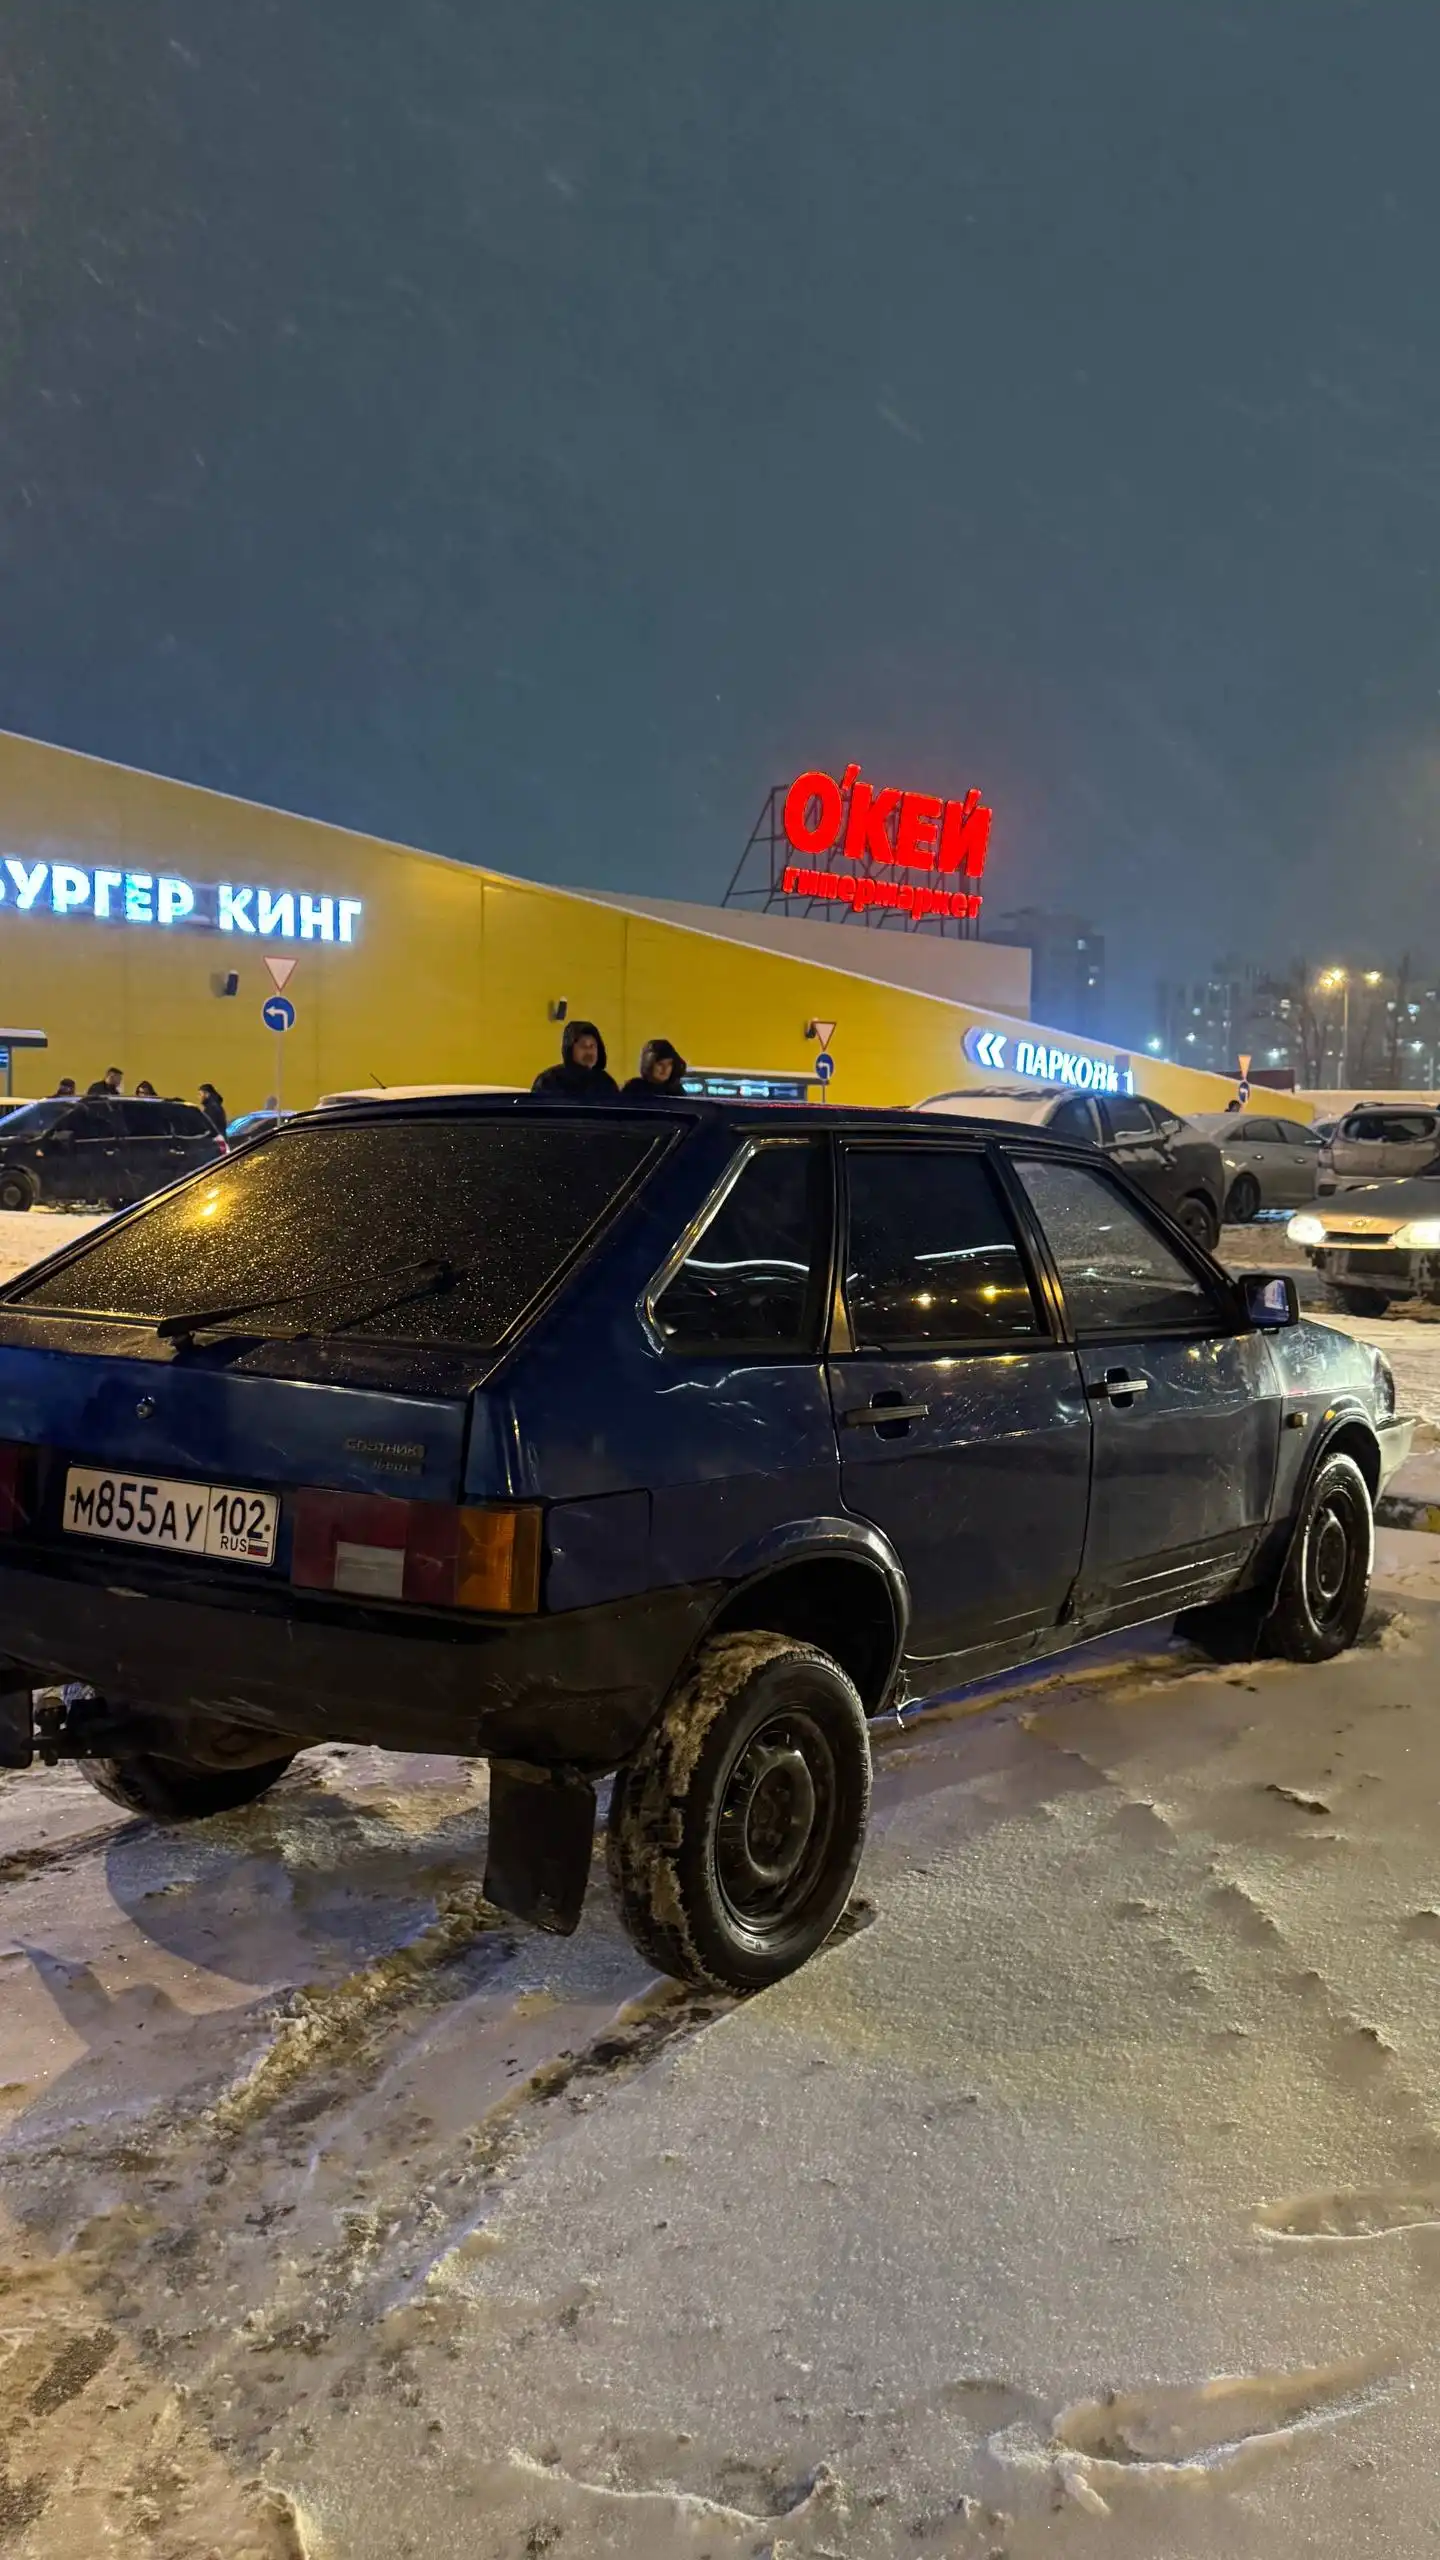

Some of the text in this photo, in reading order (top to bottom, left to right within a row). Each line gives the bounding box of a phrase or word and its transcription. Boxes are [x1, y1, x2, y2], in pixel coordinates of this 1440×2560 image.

[0, 856, 363, 943] УРГЕР КИНГ
[781, 866, 984, 921] гипермаркет
[213, 1494, 267, 1539] 102
[220, 1535, 247, 1553] RUS
